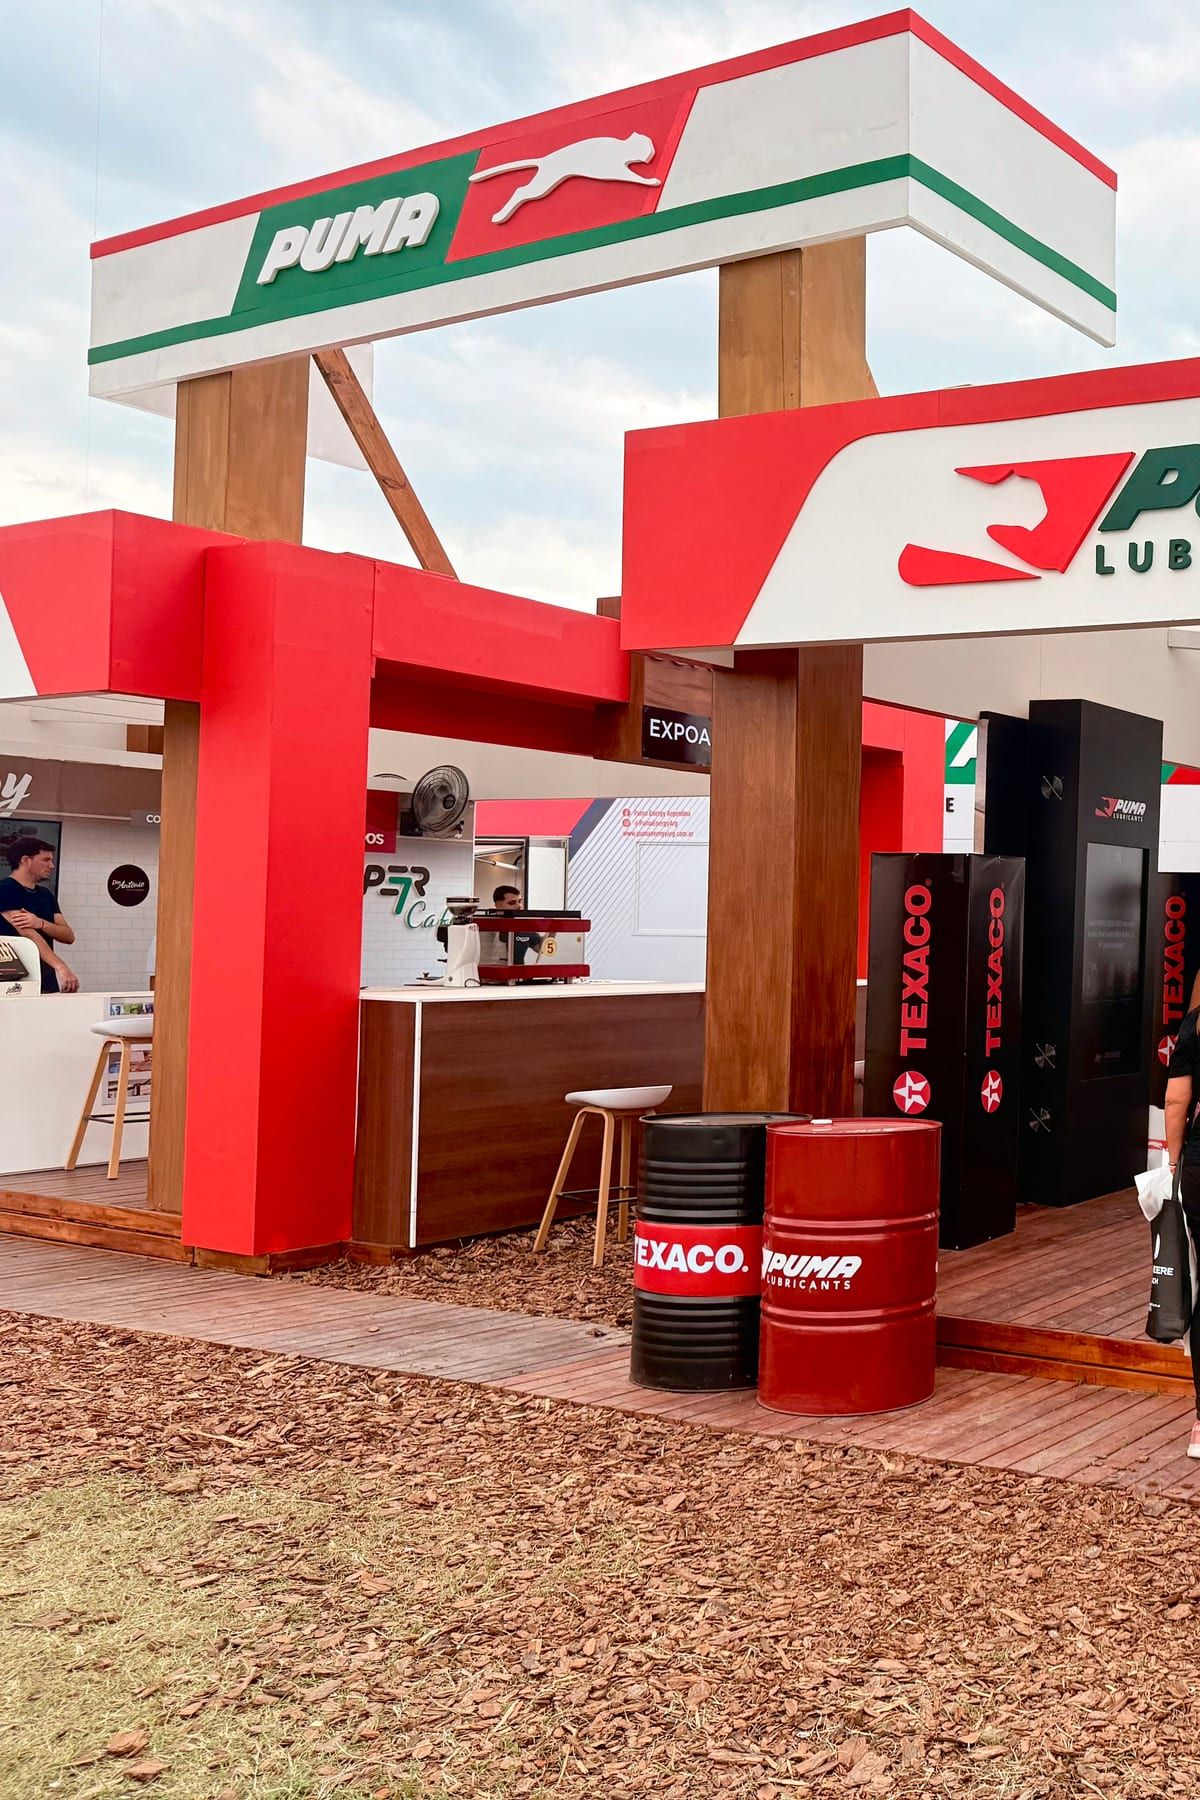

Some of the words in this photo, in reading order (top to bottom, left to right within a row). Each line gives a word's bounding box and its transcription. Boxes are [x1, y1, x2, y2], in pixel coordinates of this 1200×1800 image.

[256, 192, 440, 285] PUMA
[1113, 813, 1143, 822] LUBRICANTS
[1114, 799, 1147, 815] PUMA
[547, 942, 554, 954] 5
[1162, 895, 1187, 1025] TEXACO
[900, 884, 932, 1057] TEXACO
[985, 887, 1006, 1057] TEXACO
[768, 1255, 862, 1279] PUMA
[766, 1276, 851, 1290] LUBRICANTS
